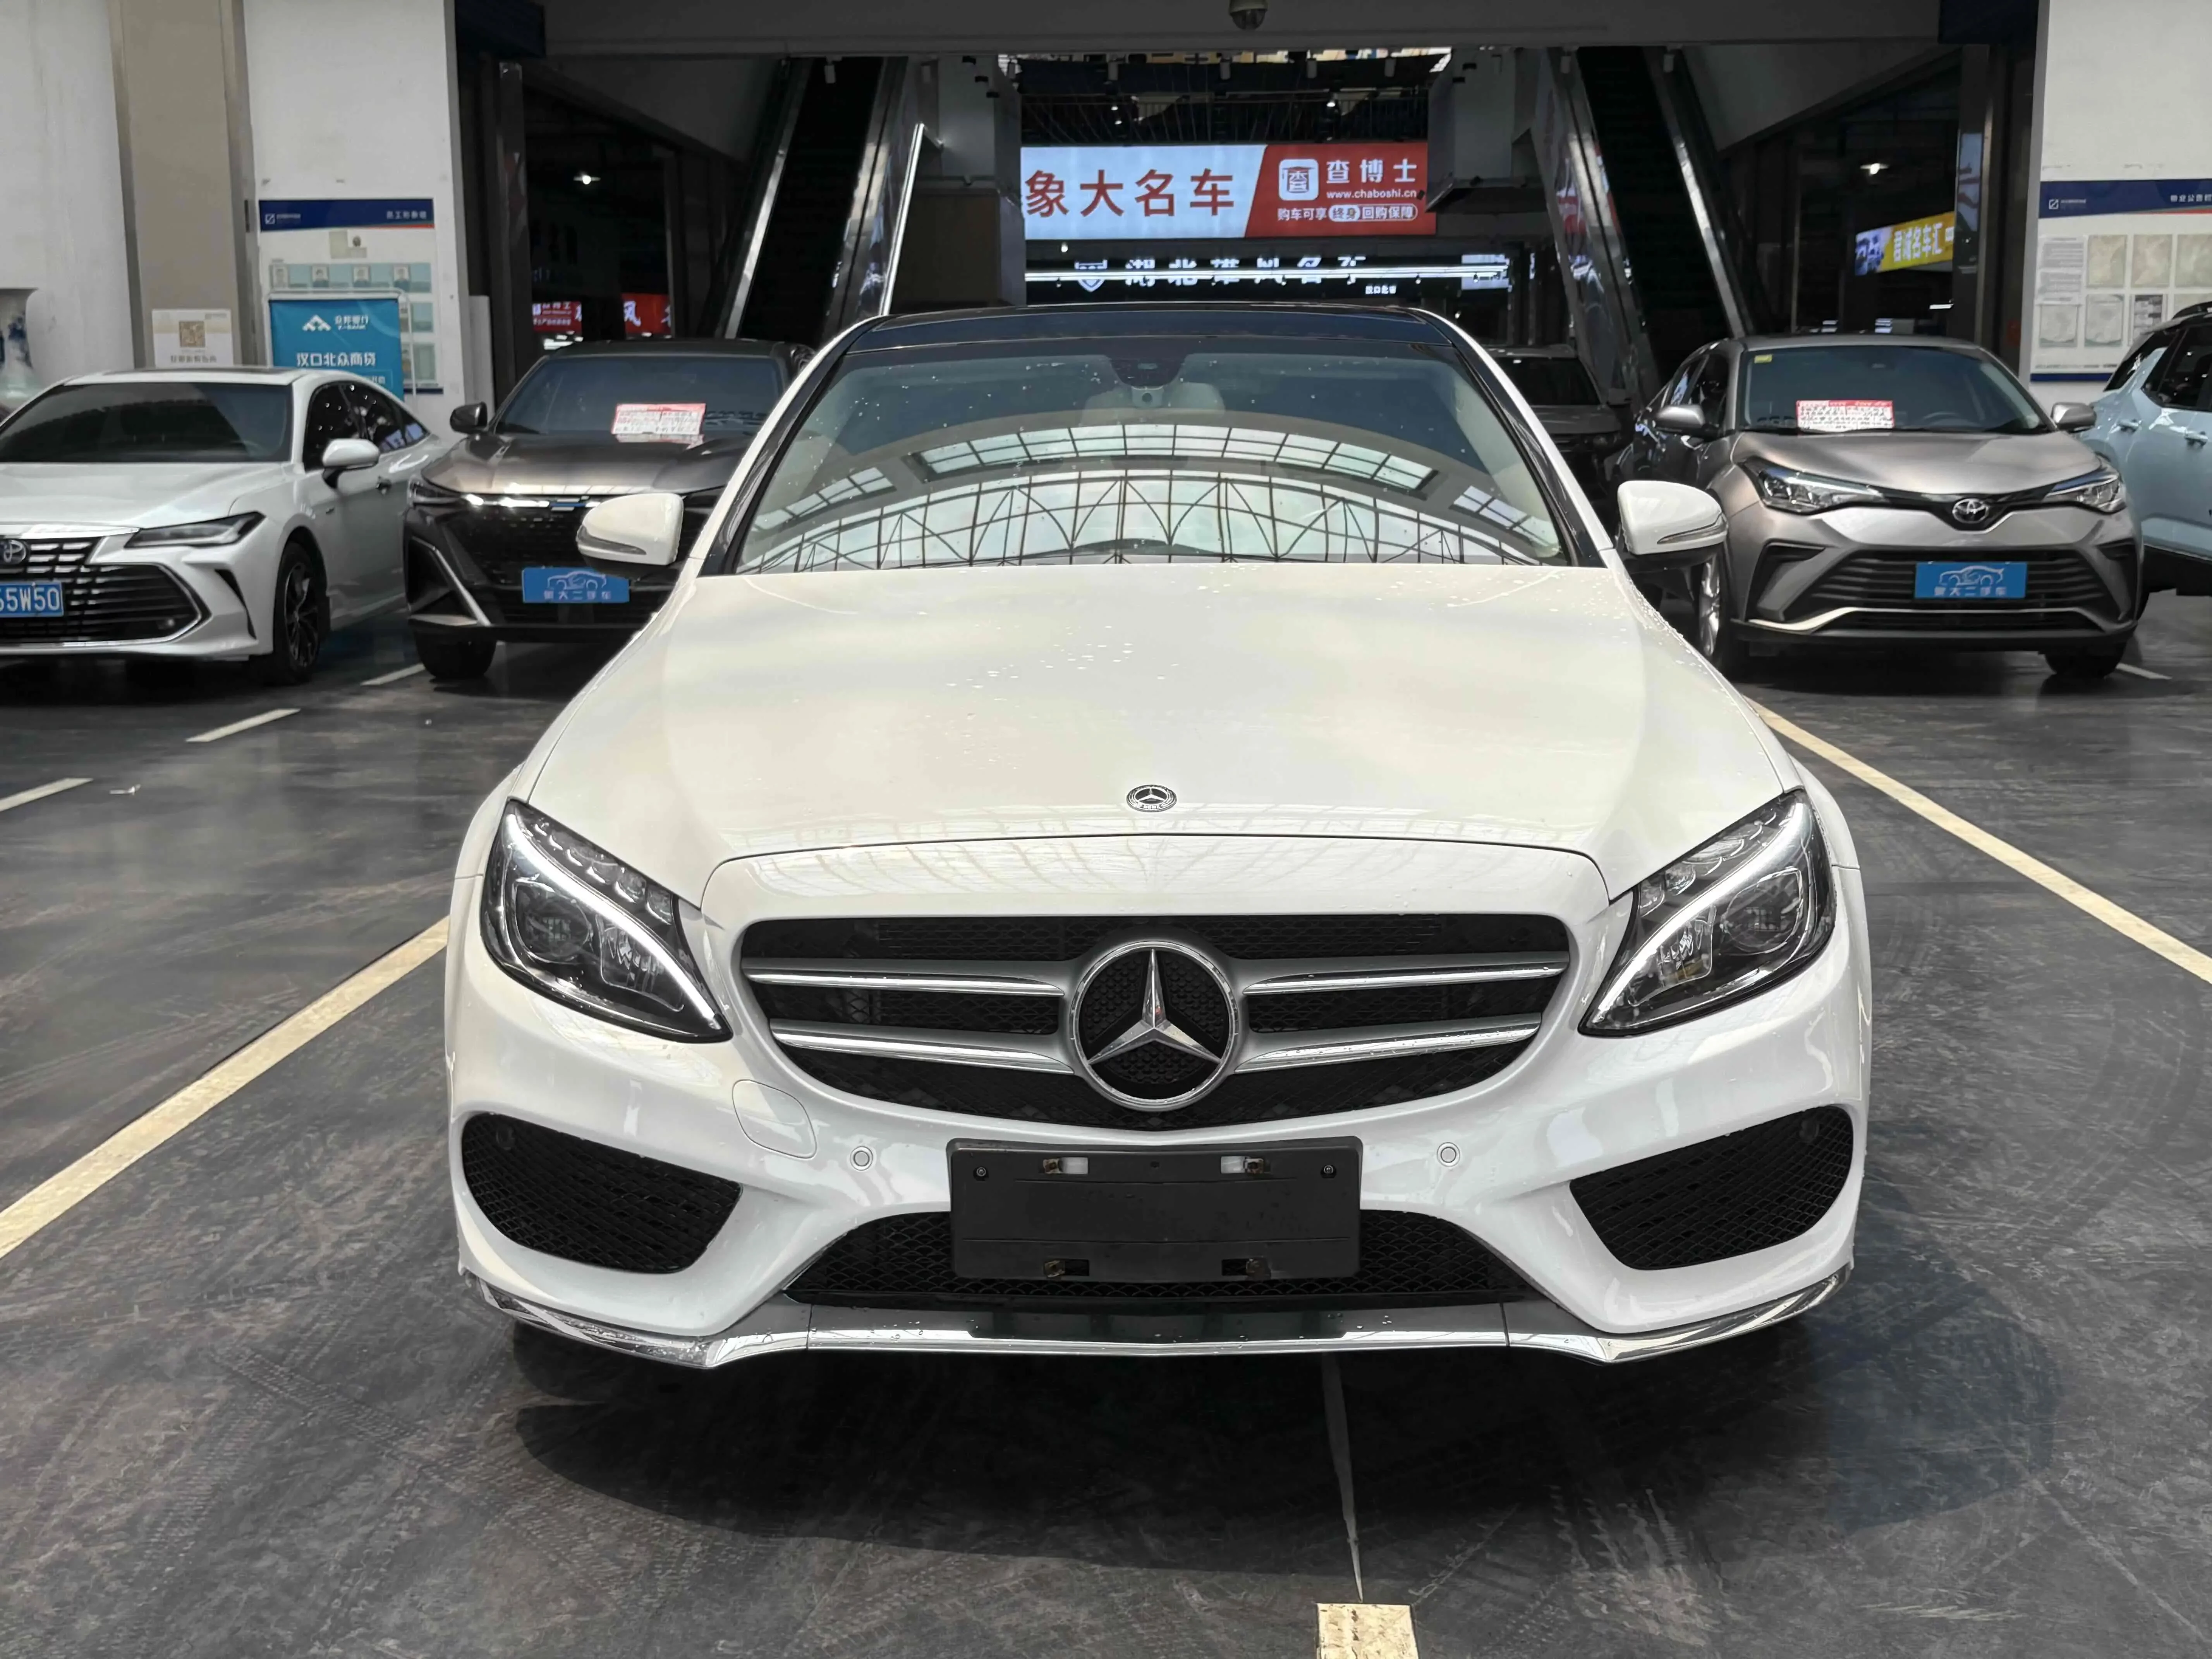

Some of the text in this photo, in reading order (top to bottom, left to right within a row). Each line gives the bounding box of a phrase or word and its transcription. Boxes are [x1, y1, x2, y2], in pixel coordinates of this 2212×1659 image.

[1326, 158, 1417, 183] 查博士
[1025, 168, 1234, 218] 象大名车
[1326, 189, 1417, 199] www.chaboshi.cn
[296, 352, 376, 367] 汉口北众商贷
